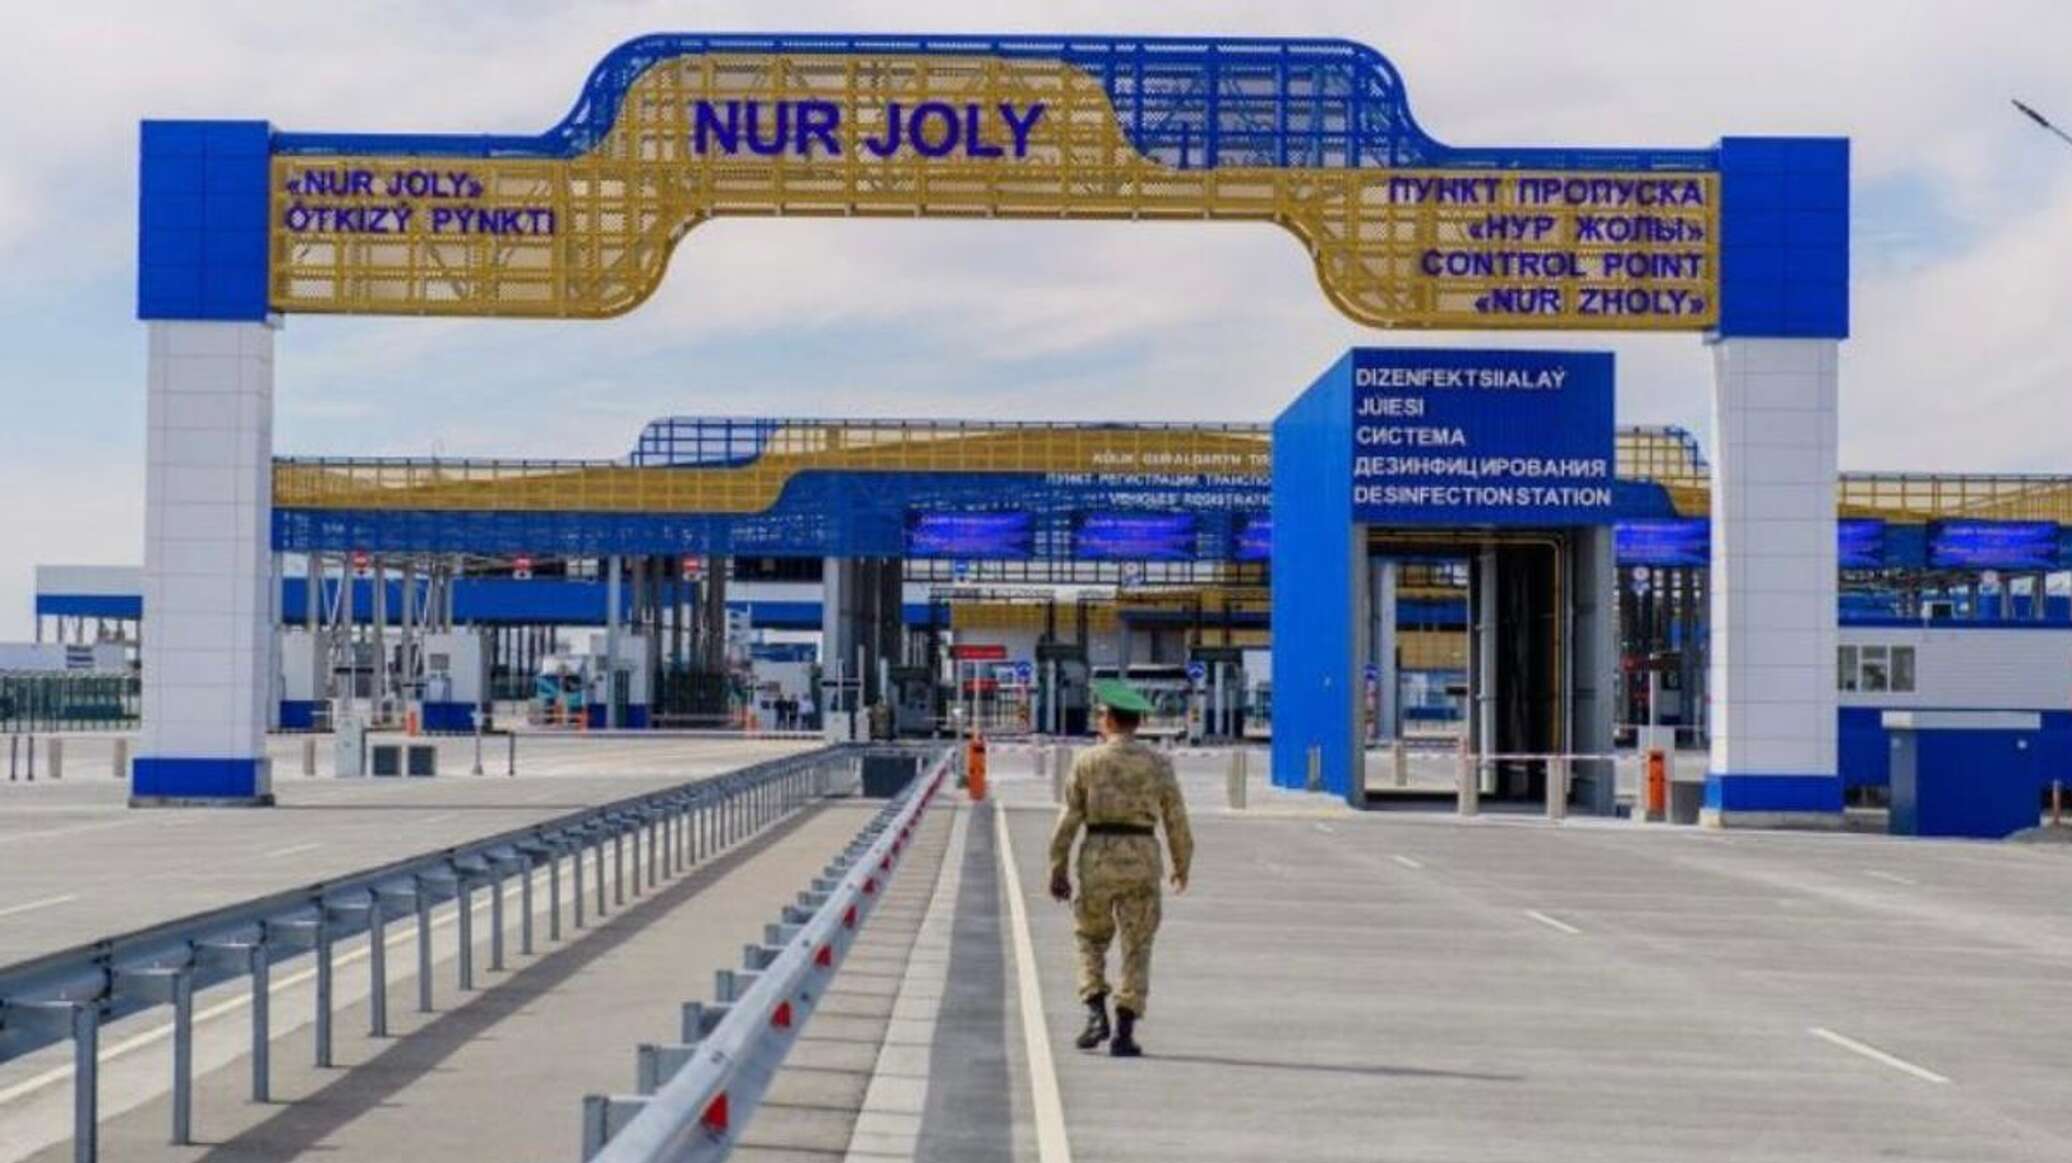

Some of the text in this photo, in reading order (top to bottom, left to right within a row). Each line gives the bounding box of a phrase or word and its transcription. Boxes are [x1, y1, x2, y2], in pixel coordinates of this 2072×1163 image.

[694, 100, 1046, 157] NUR JOLY
[286, 169, 484, 198] «NUR JOLY»
[1388, 177, 1704, 206] ПУНКТ ПРОПУСКА
[1468, 215, 1704, 242] «НУР ЖОЛЫ»
[1421, 249, 1704, 278] CONTROL POINT
[1474, 287, 1705, 315] «NUR ZHOLY»
[1356, 427, 1466, 447] СИСТЕМА
[1354, 456, 1607, 479] ДЕЗИНФИЦИРОВАНИЯ
